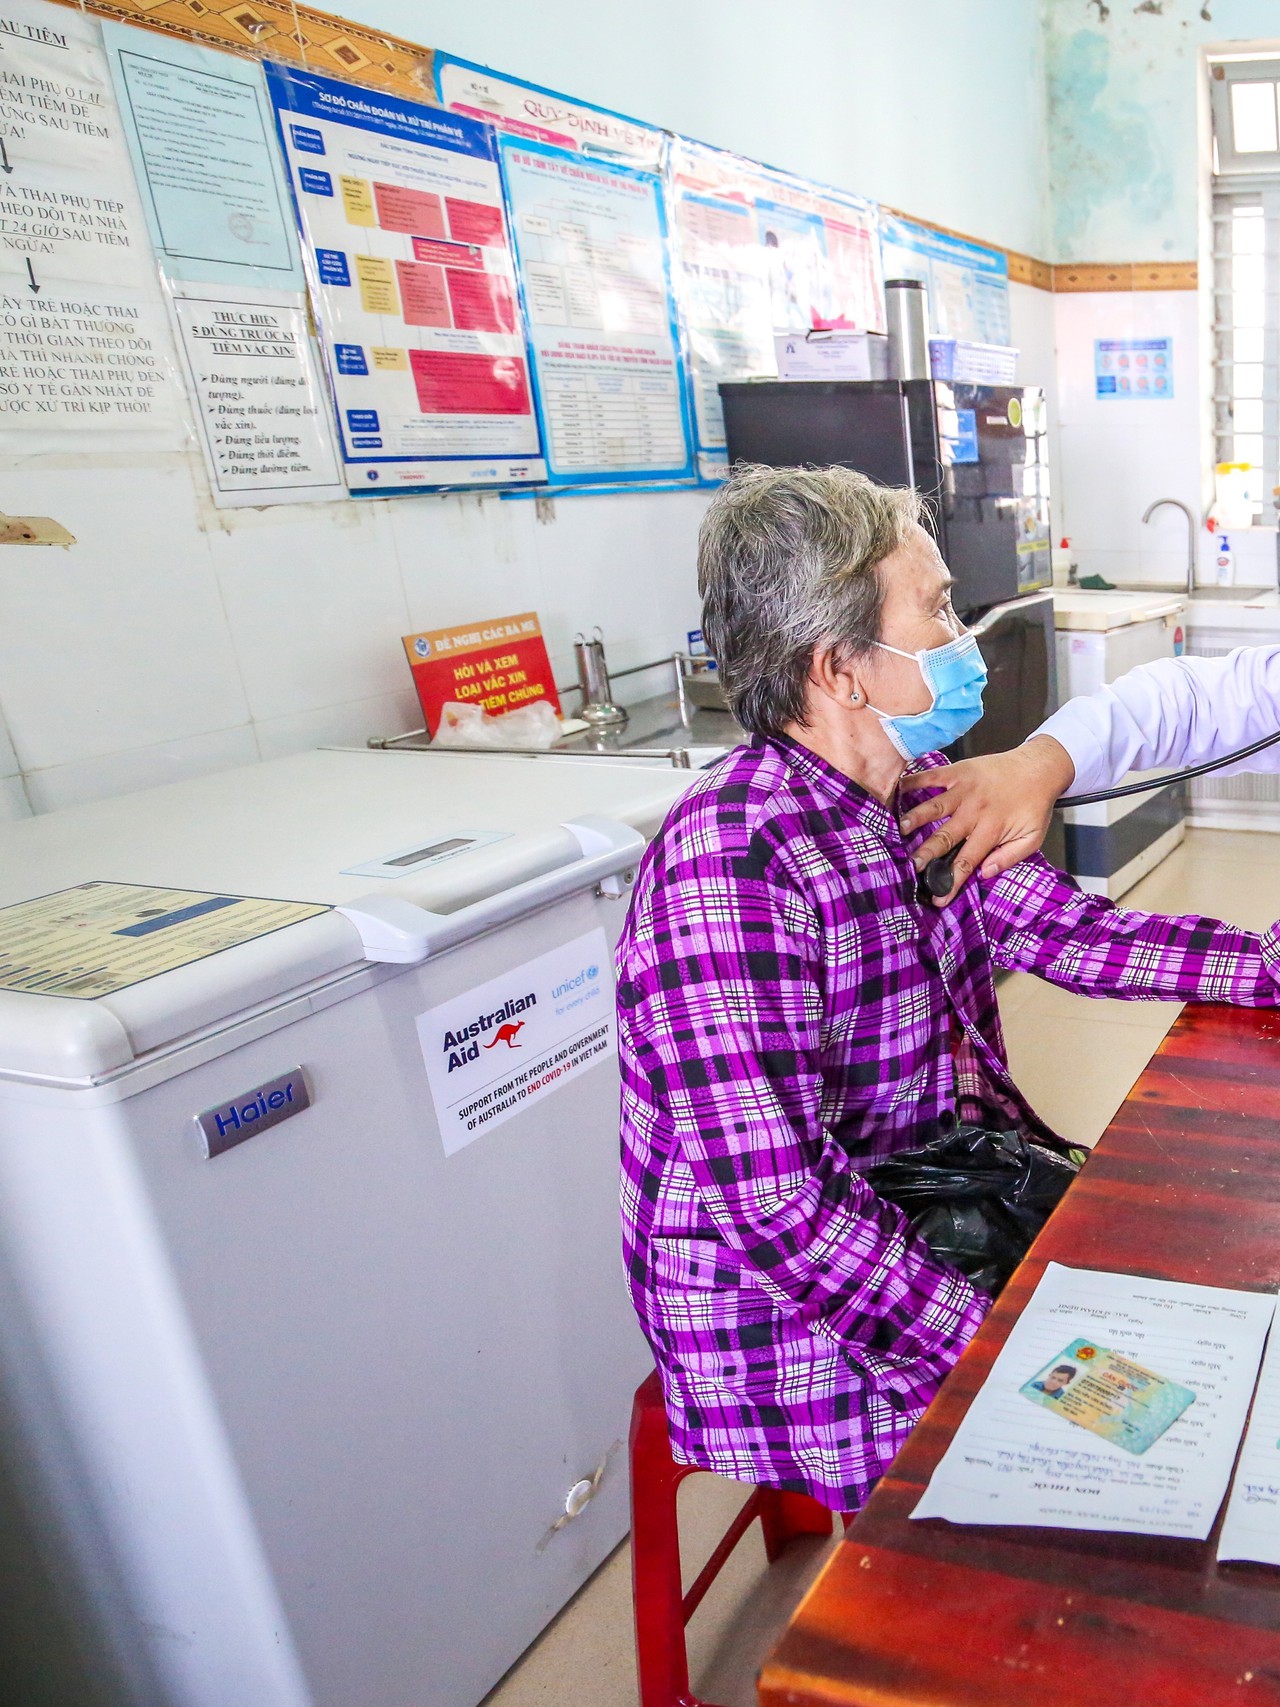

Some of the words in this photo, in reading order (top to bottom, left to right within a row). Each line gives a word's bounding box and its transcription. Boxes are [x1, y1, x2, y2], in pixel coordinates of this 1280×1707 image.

[24, 25, 67, 47] TIÊM
[27, 94, 66, 113] TIÊM
[40, 114, 69, 131] SAU
[73, 120, 109, 139] TIÊM
[19, 187, 58, 204] THAI
[61, 193, 91, 211] PHỤ
[13, 220, 27, 233] 24
[62, 228, 93, 241] SAU
[95, 231, 130, 247] TIÊM
[104, 305, 139, 319] THAI
[192, 326, 198, 336] 5
[47, 334, 84, 347] GIAN
[87, 336, 125, 349] THEO
[210, 341, 242, 353] TIÊM
[52, 351, 104, 364] NHANH
[70, 368, 105, 381] THAI
[211, 373, 238, 386] Đúng
[23, 383, 33, 395] Y
[218, 405, 245, 417] Đúng
[225, 435, 252, 447] Đúng
[228, 451, 256, 462] Đúng
[231, 465, 258, 476] Đúng
[454, 630, 482, 648] NGHỊ
[483, 626, 504, 642] CÁC
[505, 622, 521, 636] BÀ
[454, 662, 475, 681] HỎI
[476, 658, 494, 675] VÀ
[494, 653, 519, 671] XEM
[454, 682, 482, 700] LOẠI
[508, 670, 527, 685] XIN
[478, 693, 508, 712] TIÊM
[551, 970, 586, 999] unicef
[554, 1007, 565, 1017] for
[566, 996, 583, 1012] every
[584, 987, 601, 1002] child
[443, 992, 537, 1052] Australian
[447, 1041, 480, 1073] Aid
[458, 1093, 493, 1120] SUPPORT
[493, 1080, 515, 1100] FROM
[514, 1072, 528, 1087] THE
[529, 1057, 554, 1079] PEOPLE
[554, 1050, 568, 1064] AND
[568, 1024, 610, 1054] GOVERNMENT
[467, 1119, 478, 1131] OF
[478, 1095, 517, 1125] AUSTRALIA
[517, 1088, 527, 1101] TO
[527, 1079, 541, 1095] END
[541, 1062, 571, 1086] COVID-19
[571, 1057, 579, 1067] IN
[579, 1050, 593, 1065] VIET
[593, 1040, 608, 1056] NAM
[215, 1082, 296, 1137] Haier
